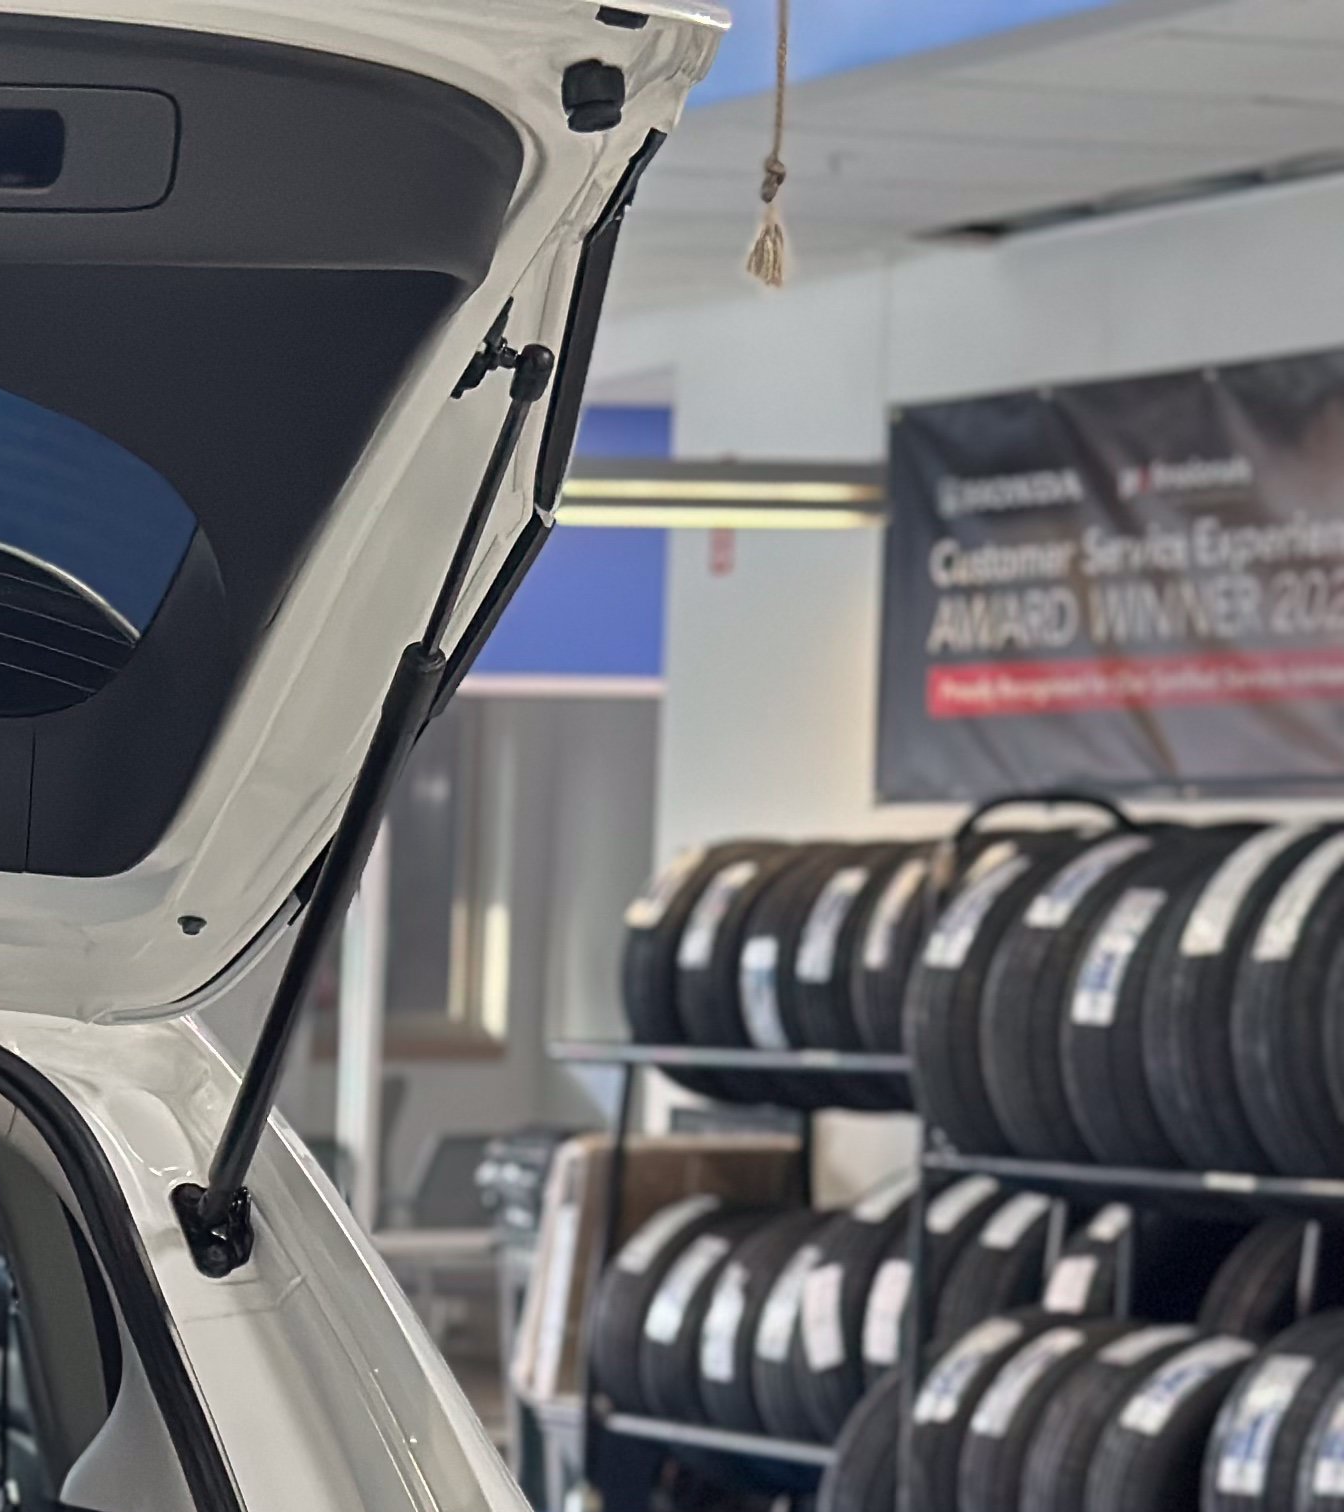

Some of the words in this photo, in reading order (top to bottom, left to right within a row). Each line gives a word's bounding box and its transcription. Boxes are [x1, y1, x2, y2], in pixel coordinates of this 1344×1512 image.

[929, 540, 1077, 587] Customer
[1083, 526, 1188, 573] Service
[928, 588, 1078, 652] AWARD
[1088, 572, 1262, 643] WINNER
